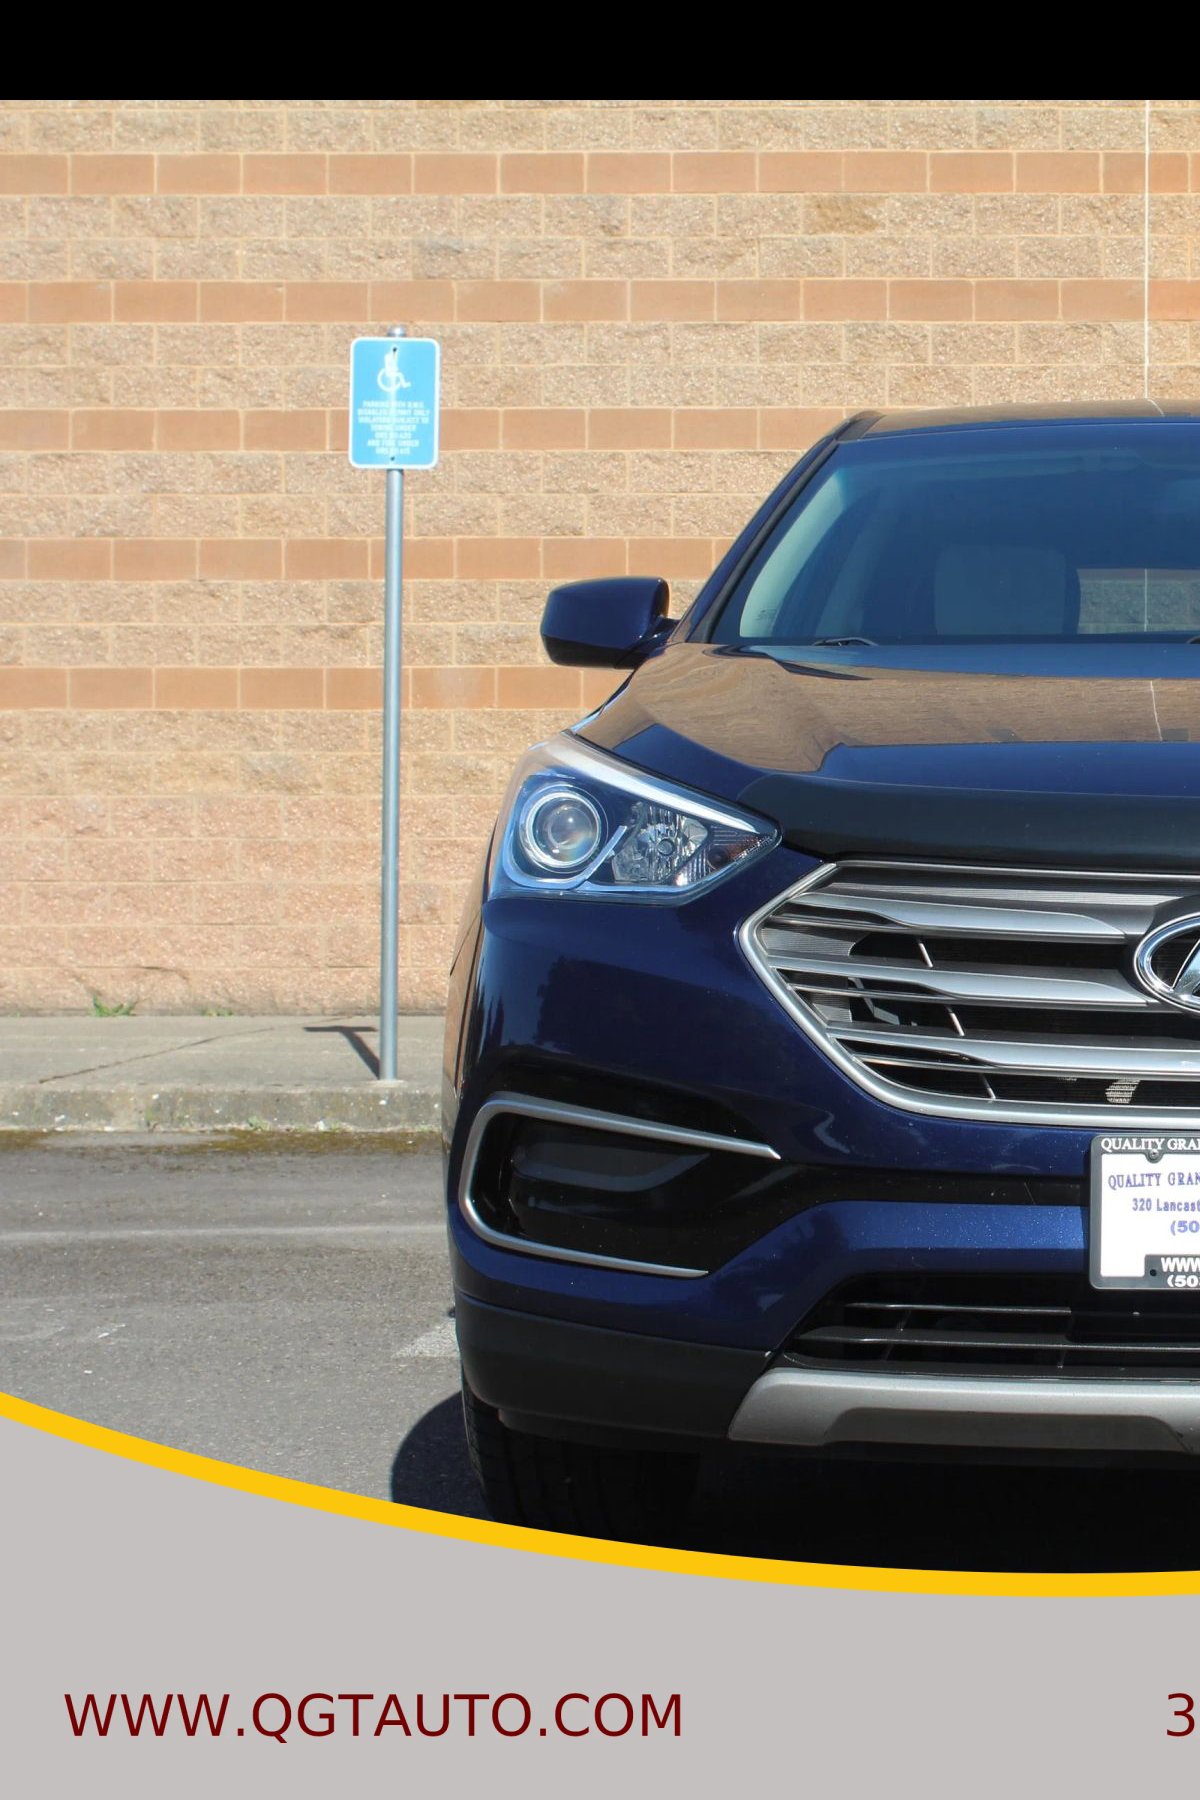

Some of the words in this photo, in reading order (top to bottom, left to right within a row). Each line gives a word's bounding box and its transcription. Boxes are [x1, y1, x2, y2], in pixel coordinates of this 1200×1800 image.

[1101, 1137, 1165, 1153] QUALITY
[1108, 1172, 1162, 1191] QUALITY
[1132, 1198, 1152, 1212] 320
